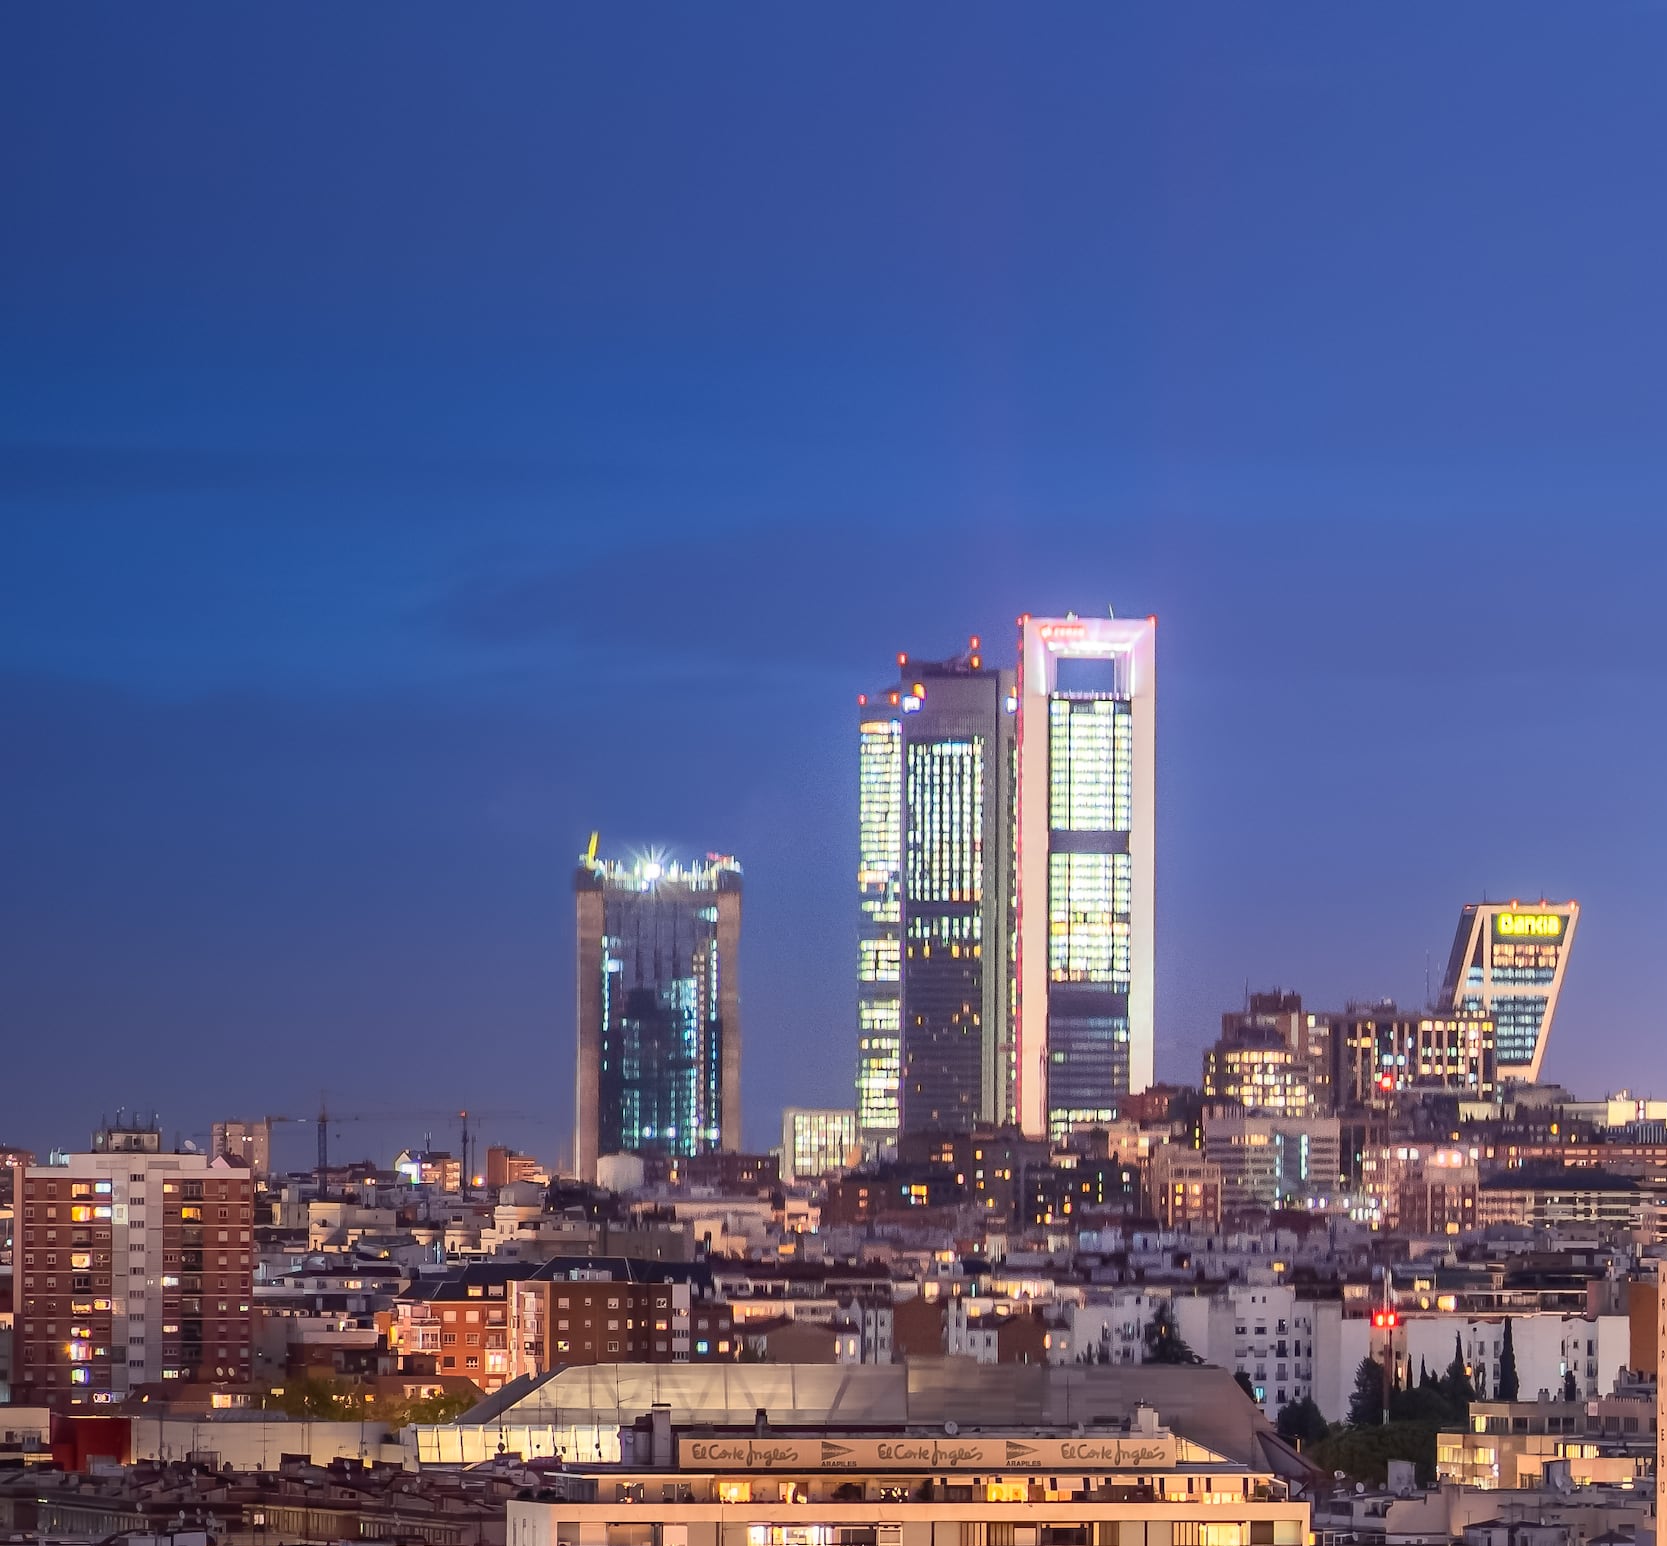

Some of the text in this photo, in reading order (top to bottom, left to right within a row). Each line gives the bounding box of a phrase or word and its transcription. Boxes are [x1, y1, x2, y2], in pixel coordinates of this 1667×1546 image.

[692, 1440, 799, 1466] El Corte Inglés
[877, 1440, 983, 1466] El Corte Inglés
[1060, 1440, 1166, 1466] El Corte Inglés
